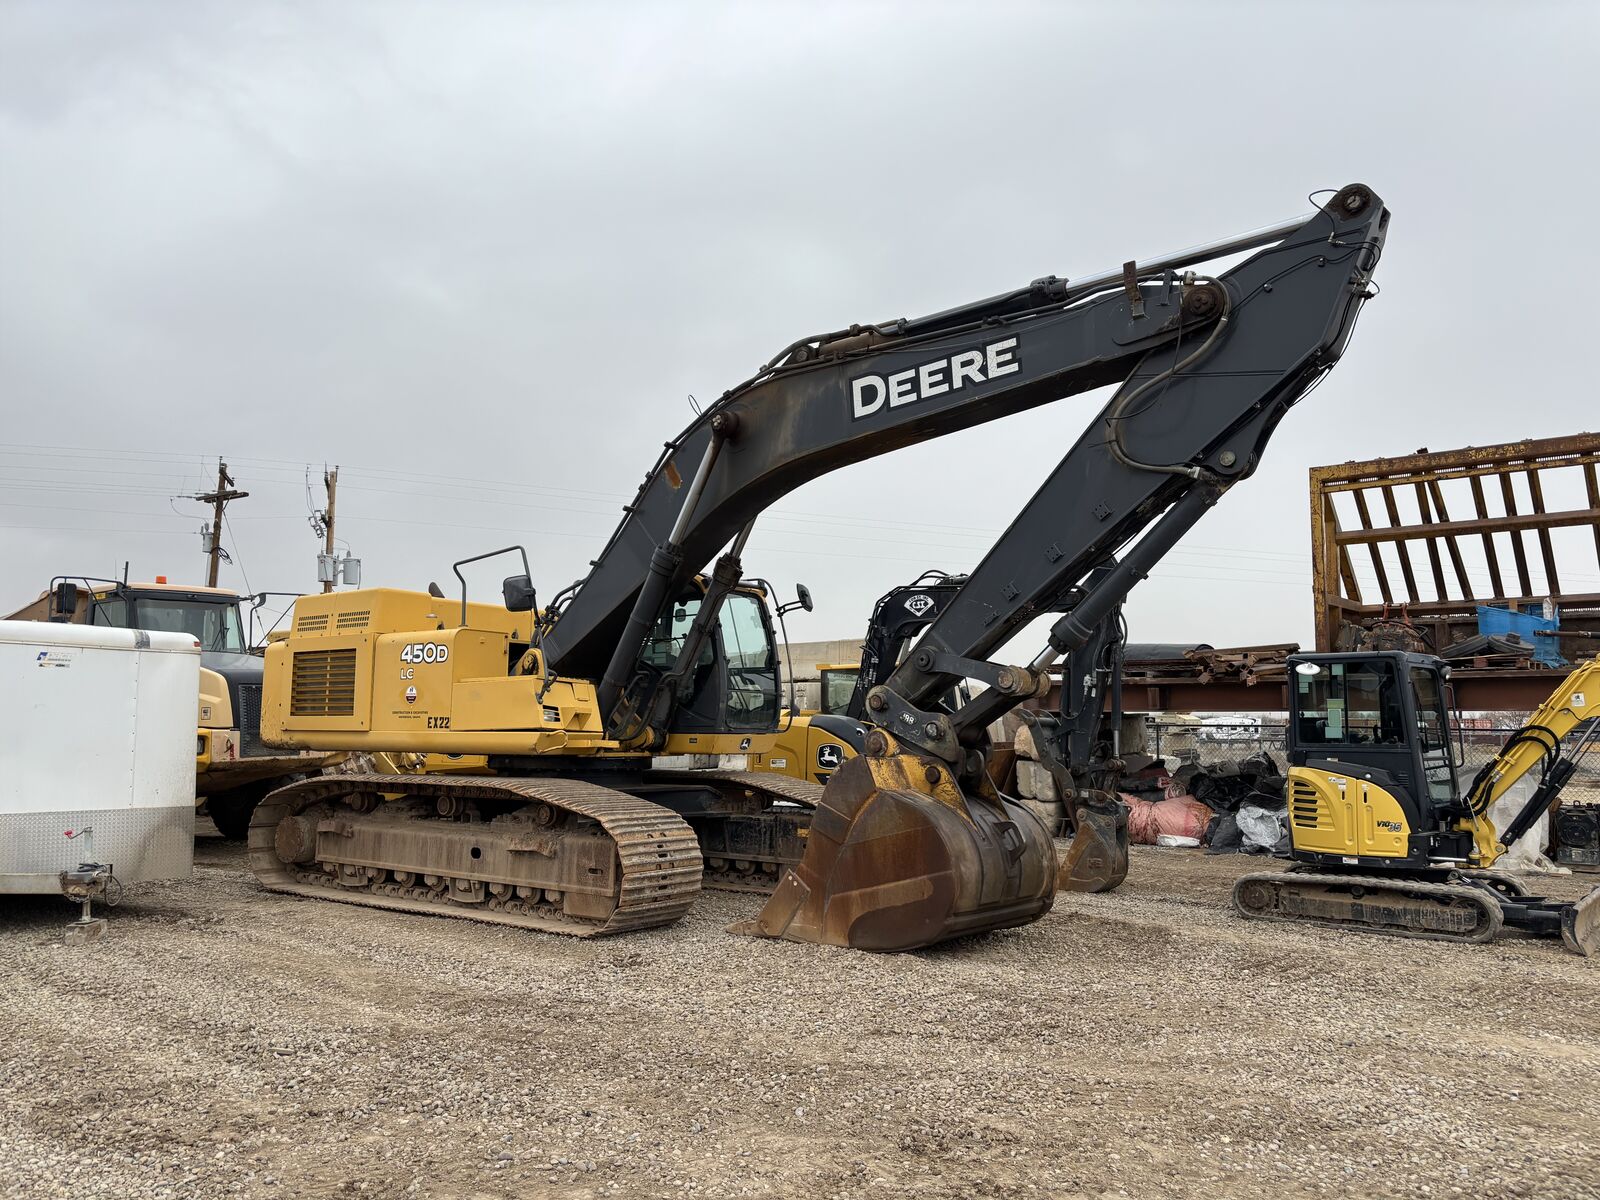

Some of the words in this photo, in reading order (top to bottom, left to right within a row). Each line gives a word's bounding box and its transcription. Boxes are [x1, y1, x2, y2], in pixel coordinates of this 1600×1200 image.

[852, 338, 1019, 418] DEERE
[912, 600, 926, 609] CSI
[400, 642, 449, 664] 450D
[400, 668, 414, 680] LC
[427, 716, 450, 729] EX22
